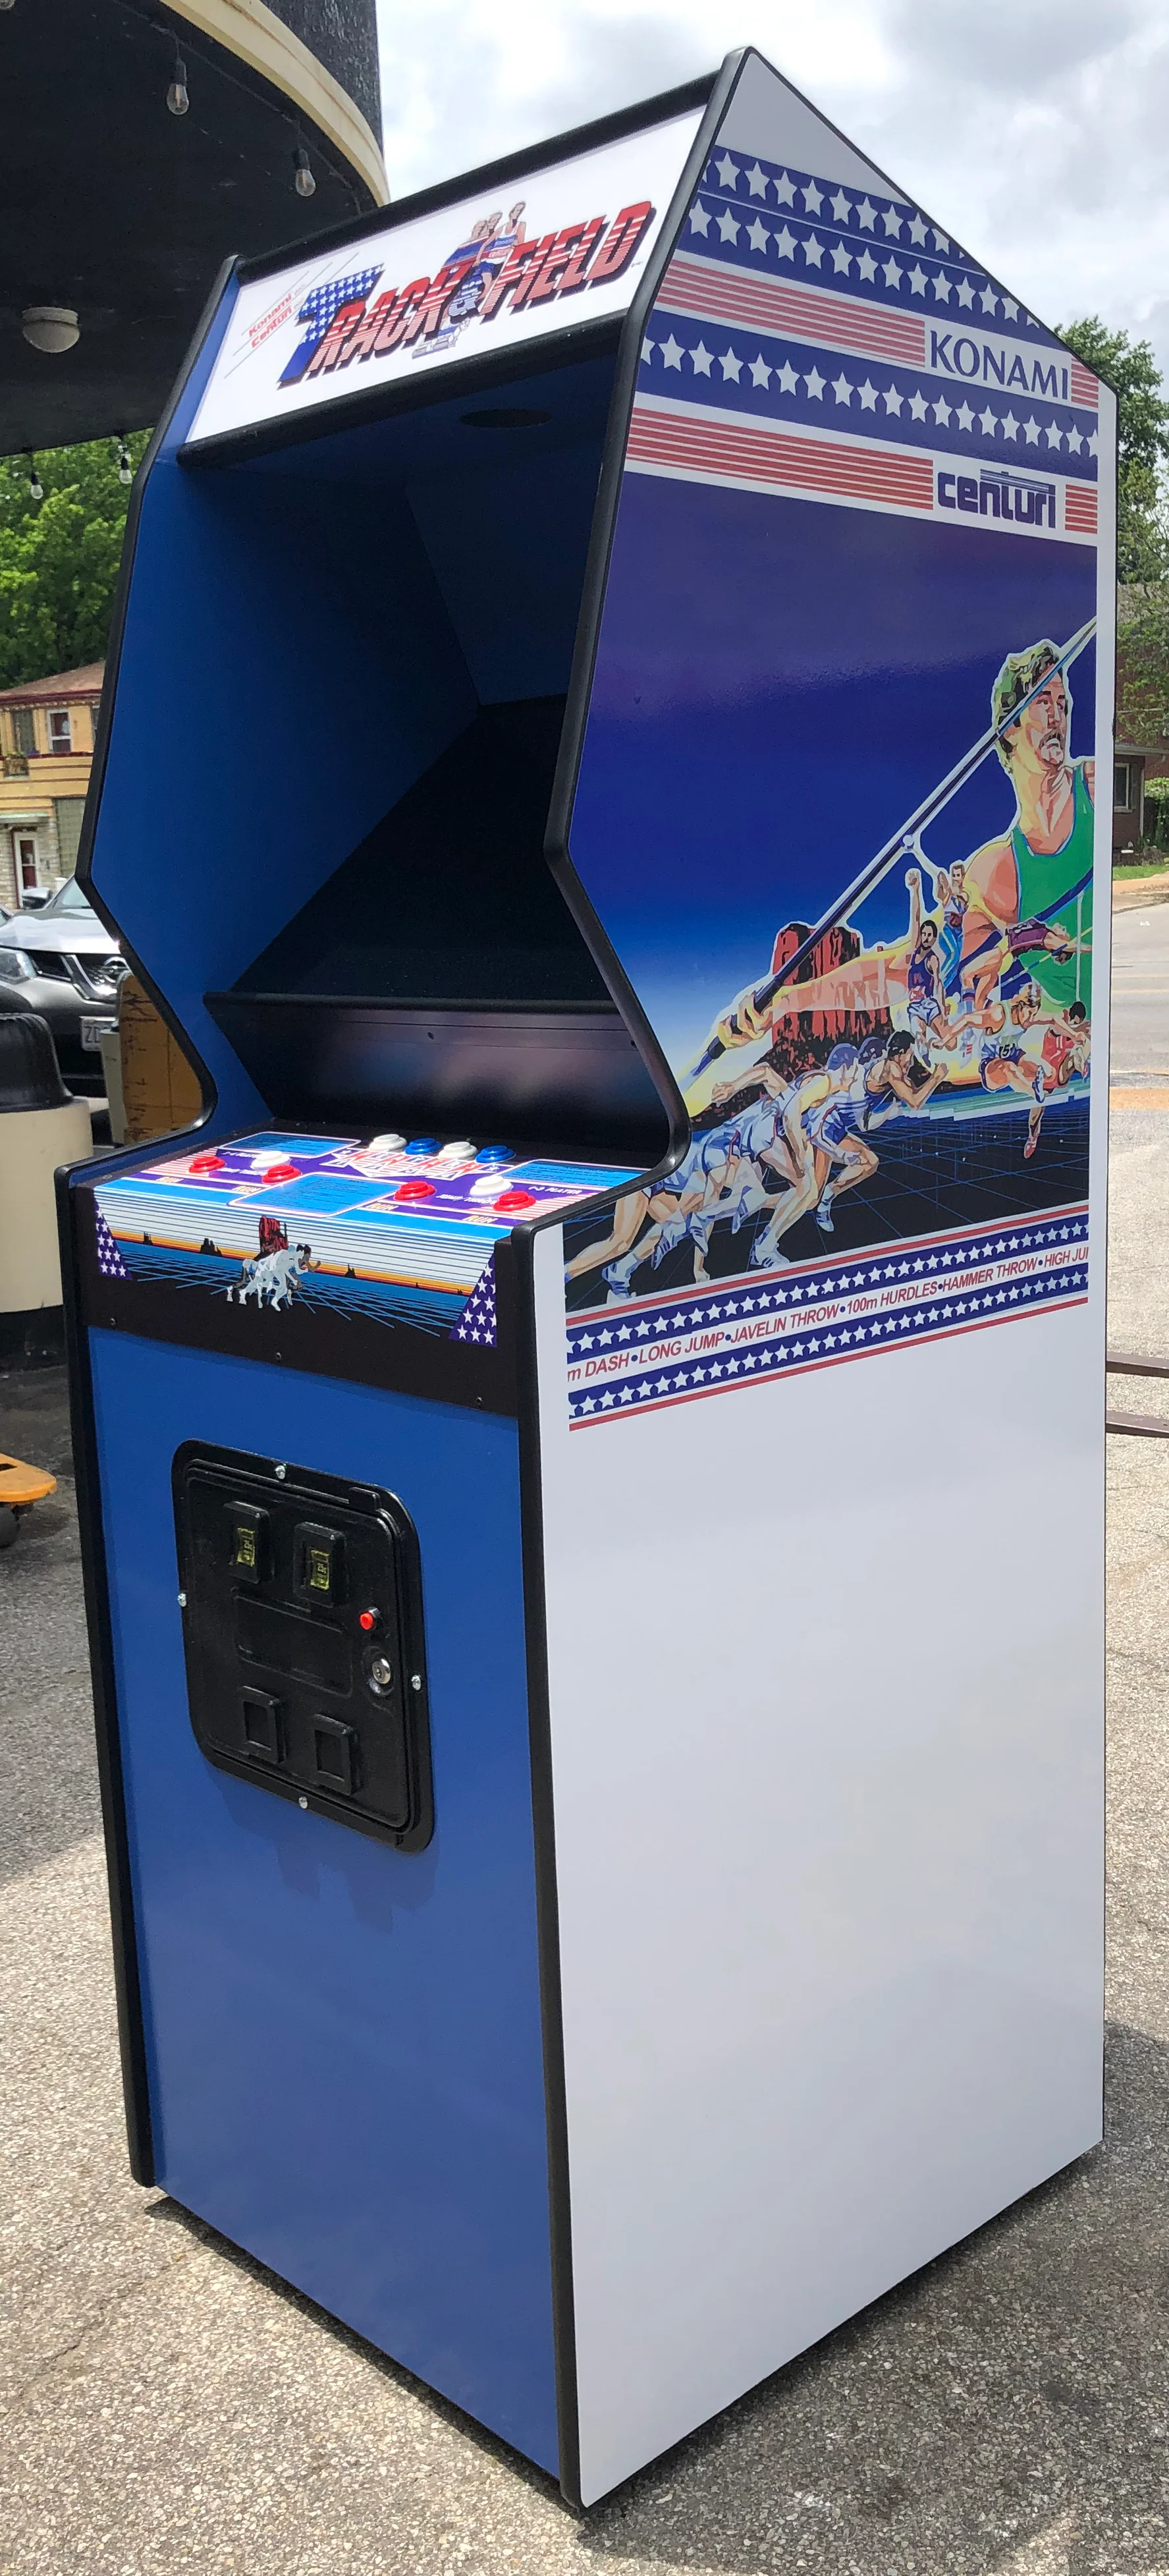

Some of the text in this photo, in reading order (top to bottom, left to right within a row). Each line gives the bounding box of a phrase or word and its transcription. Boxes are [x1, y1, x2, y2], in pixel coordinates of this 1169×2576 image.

[249, 294, 292, 337] Konami
[277, 262, 472, 390] TRACK
[478, 200, 657, 325] FIELD
[931, 330, 1068, 400] KONAMI
[365, 1202, 400, 1211] RUN
[462, 1215, 499, 1224] RUN
[584, 1353, 630, 1378] DASH
[639, 1340, 682, 1364] LONG
[684, 1331, 724, 1353] JUMP
[731, 1316, 787, 1343] JAVELIN
[790, 1303, 839, 1328] THROW
[847, 1298, 877, 1314] 100m
[880, 1283, 938, 1306] HURDLES
[942, 1268, 994, 1292] HAMMER
[996, 1256, 1038, 1278] THROW
[1044, 1250, 1071, 1268] HIGH
[1072, 1246, 1089, 1262] JU
